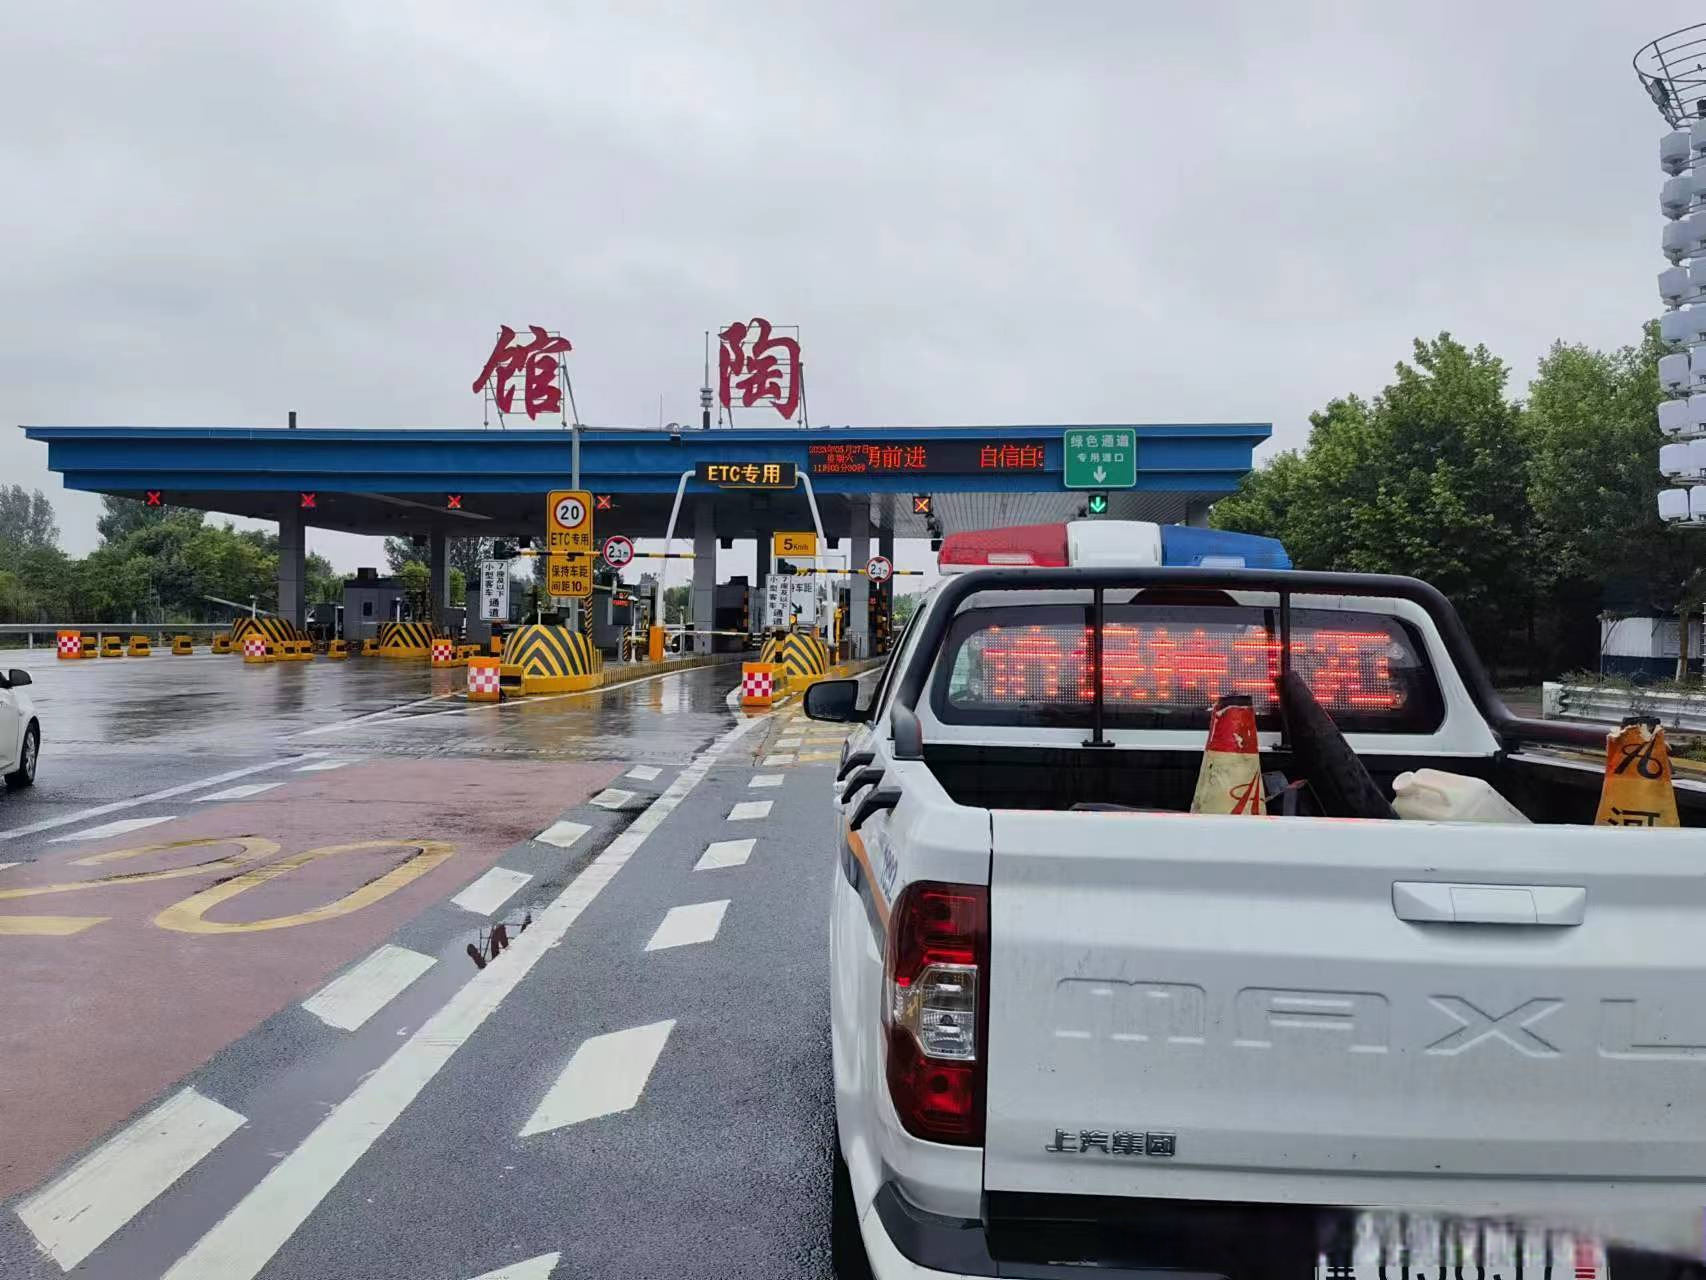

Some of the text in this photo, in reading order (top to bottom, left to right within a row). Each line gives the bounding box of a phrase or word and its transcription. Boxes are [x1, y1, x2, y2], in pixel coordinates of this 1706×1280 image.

[1070, 434, 1129, 449] 绿色通道
[1077, 452, 1124, 463] 专用道口
[708, 464, 781, 484] ETC专用
[560, 505, 580, 520] 20
[551, 532, 589, 546] ETC专用
[551, 565, 588, 577] 保持车距
[484, 563, 494, 597] 小型客车
[551, 581, 589, 592] 间距10m
[769, 576, 778, 608] 小型客车
[488, 598, 499, 617] 通道
[773, 609, 783, 625] 通道
[1046, 1128, 1177, 1156] 上汽集团
